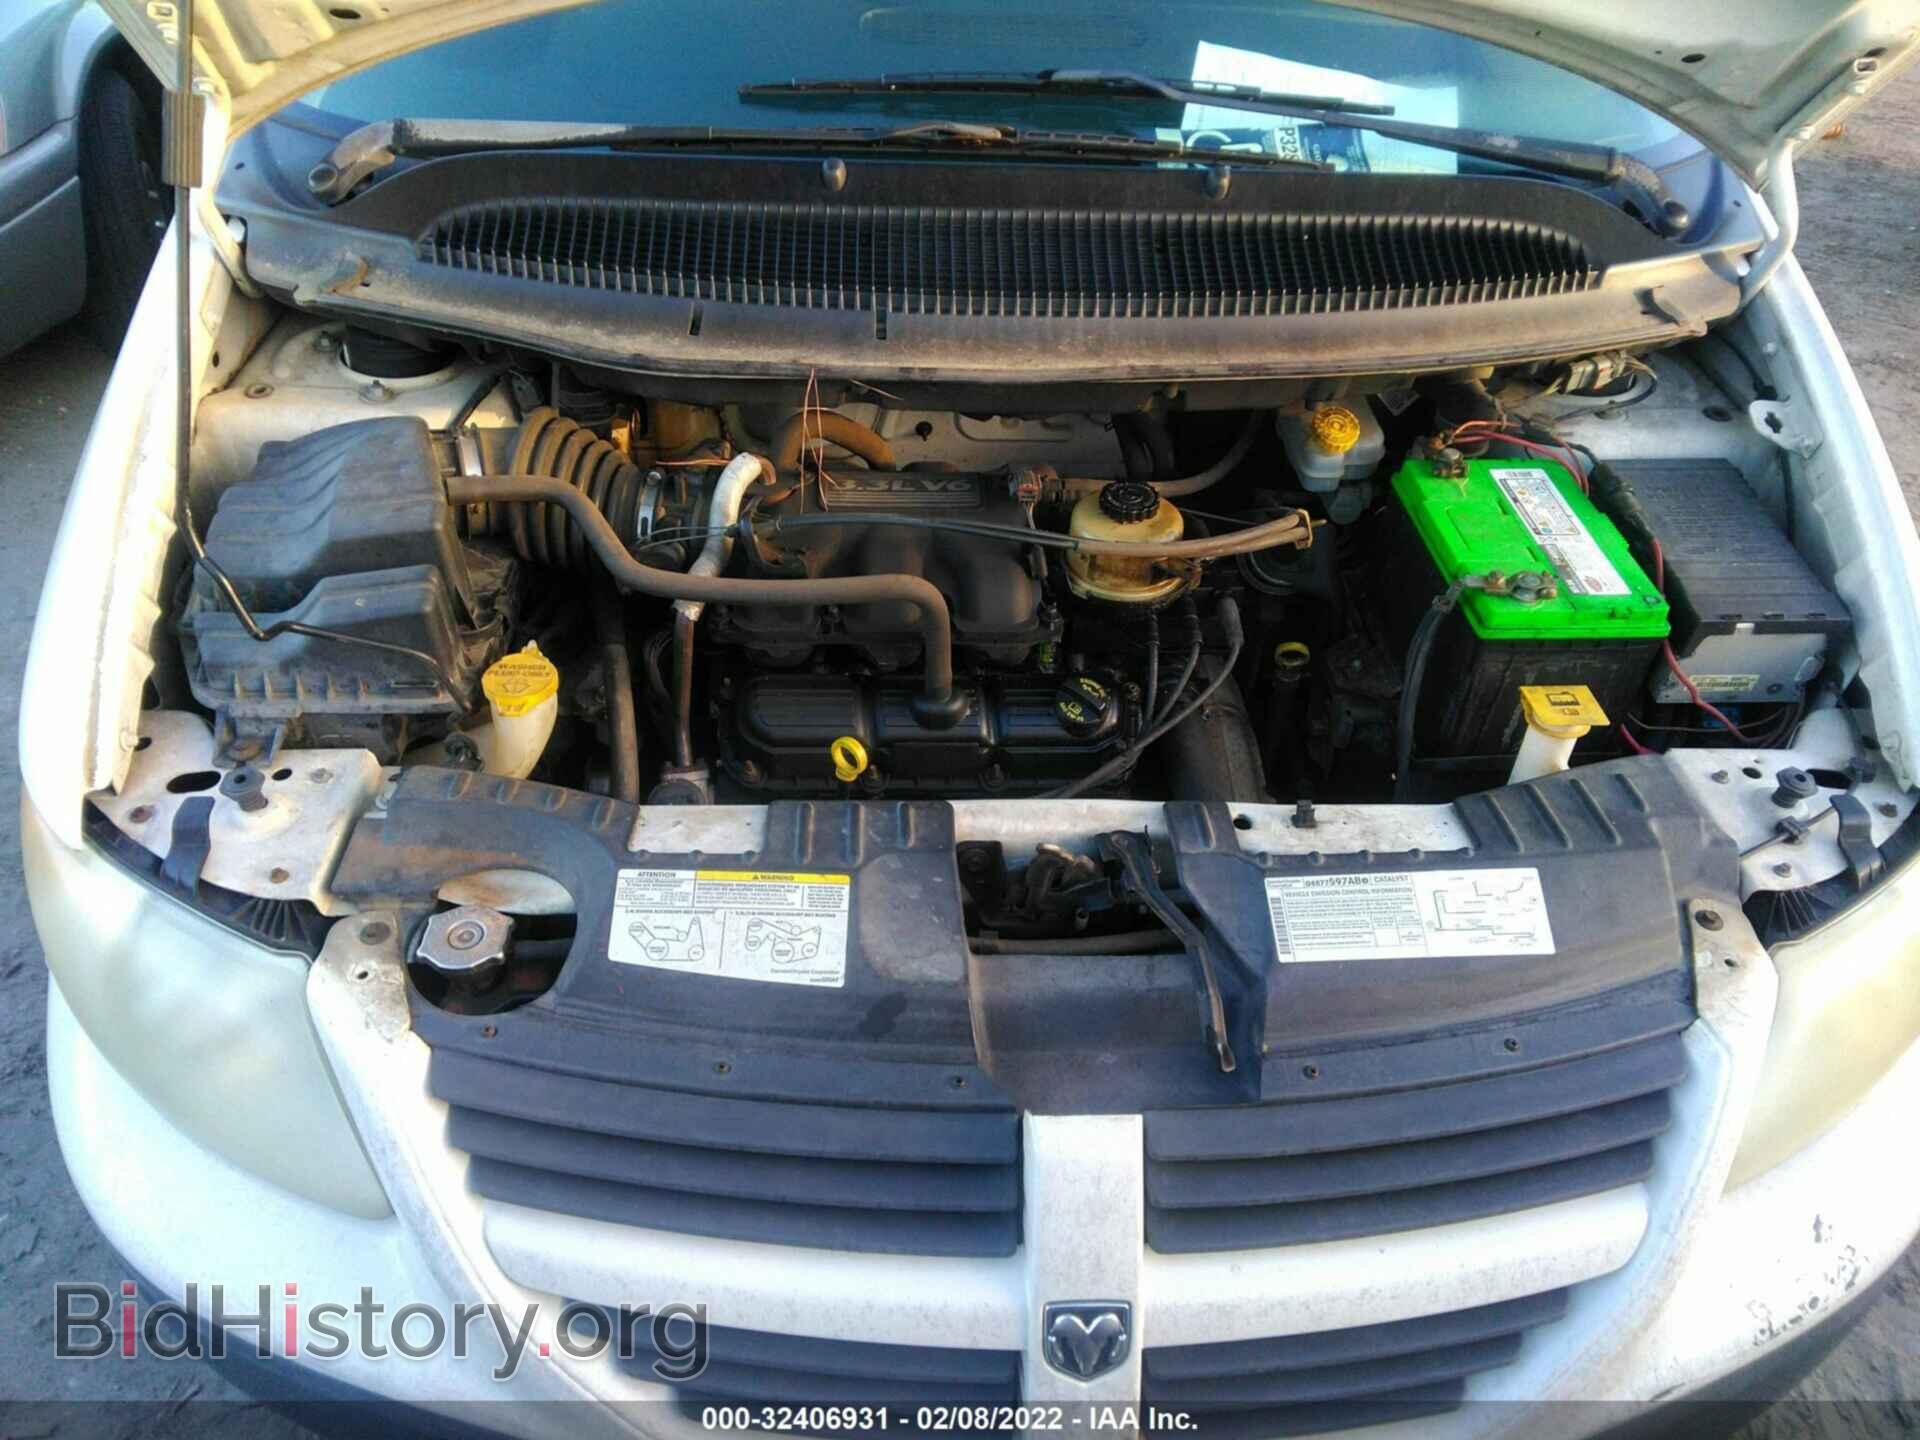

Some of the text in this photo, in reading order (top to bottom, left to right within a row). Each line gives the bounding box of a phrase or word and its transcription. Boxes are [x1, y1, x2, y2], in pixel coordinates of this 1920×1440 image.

[920, 479, 972, 491] V6
[637, 871, 676, 879] ATTENTION
[1374, 875, 1409, 883] CATALYST
[1285, 890, 1310, 898] VEHICLE
[1311, 889, 1341, 897] EMISSION
[1371, 887, 1413, 895] INFORMATION
